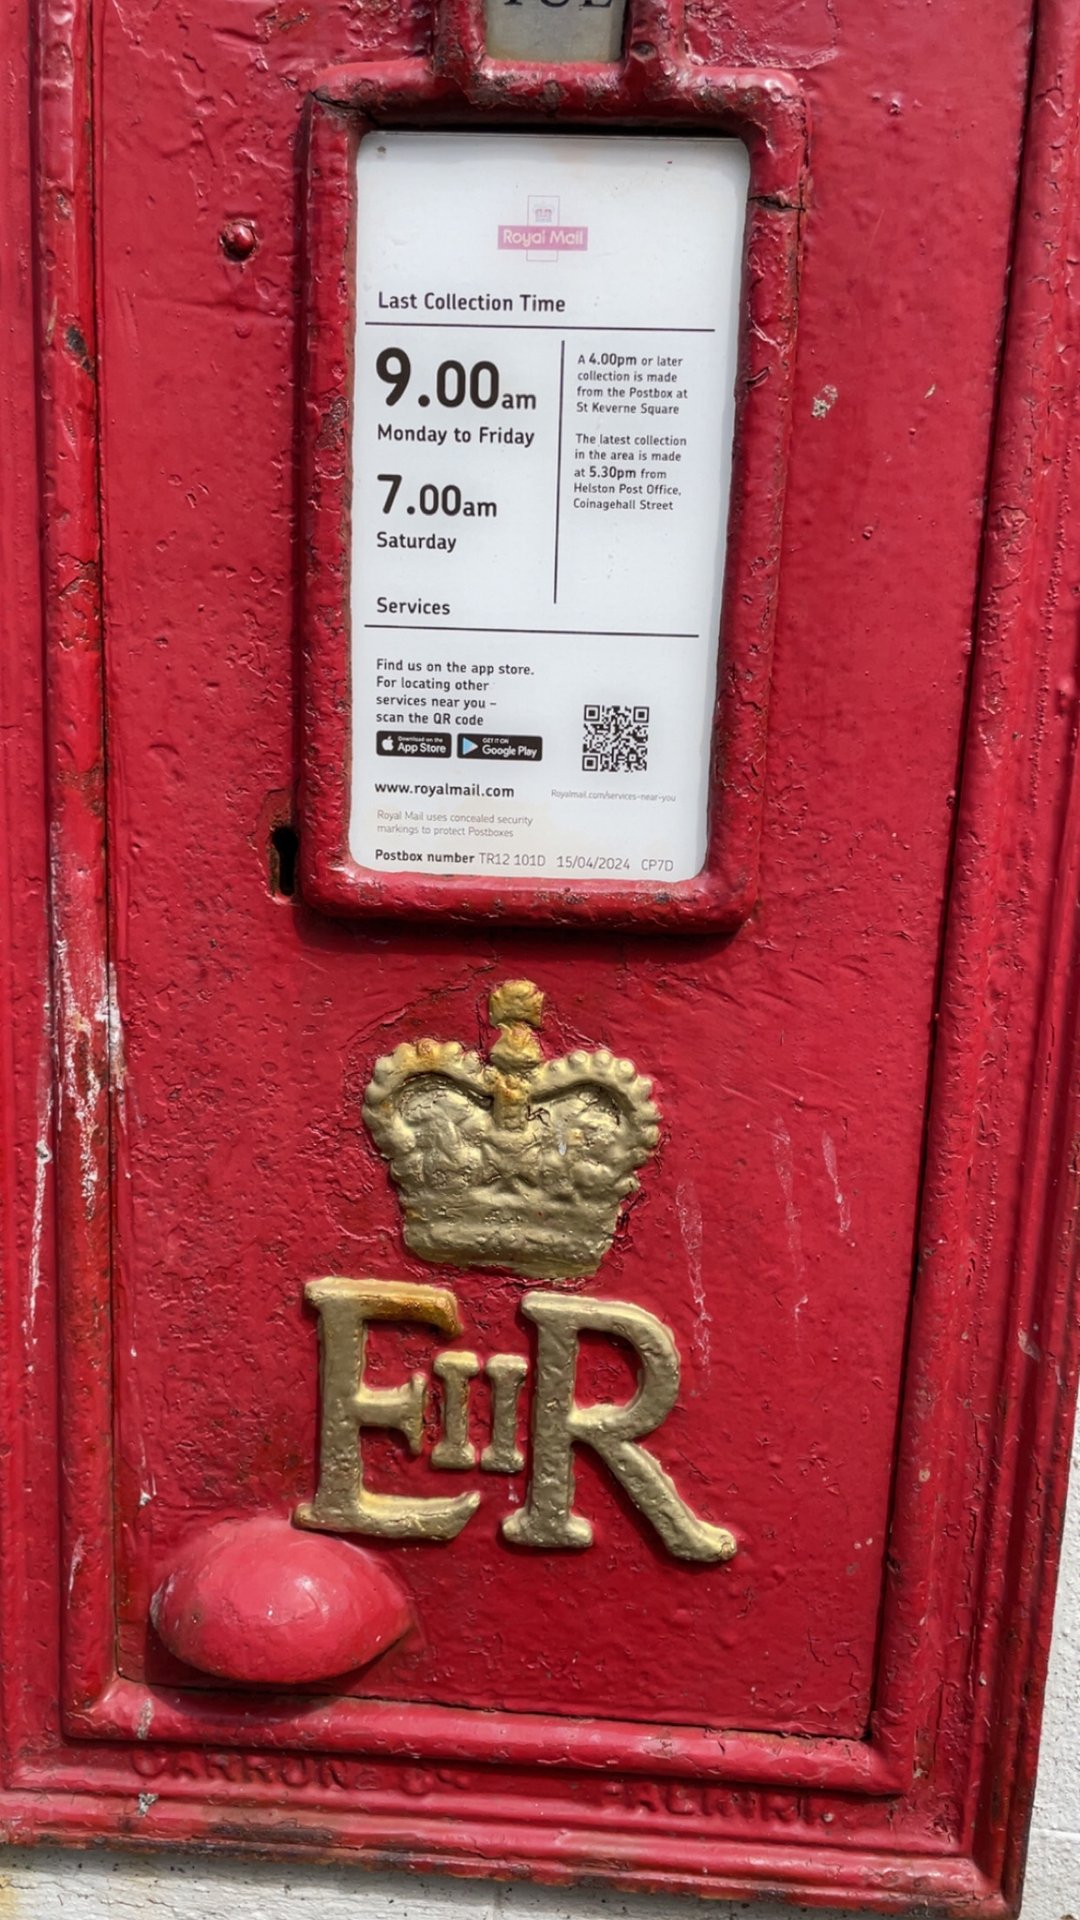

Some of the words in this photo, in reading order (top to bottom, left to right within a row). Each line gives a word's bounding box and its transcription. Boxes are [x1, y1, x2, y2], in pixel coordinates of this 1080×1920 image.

[502, 227, 546, 248] Royal
[549, 229, 584, 245] Mail
[378, 291, 418, 310] Last
[424, 292, 513, 312] Collection
[519, 294, 566, 313] Time
[577, 354, 586, 365] A
[588, 352, 637, 368] 4.00pm
[640, 357, 654, 367] or
[656, 355, 684, 367] later
[375, 346, 537, 410] 9.00am
[577, 370, 630, 382] collection
[633, 370, 644, 383] is
[646, 371, 678, 383] made
[576, 385, 604, 397] from
[606, 386, 626, 398] the
[629, 386, 673, 399] Postbox
[676, 388, 688, 399] at
[576, 401, 588, 413] St
[591, 401, 637, 414] Keverne
[640, 402, 680, 416] Square
[377, 423, 448, 446] Monday
[453, 427, 472, 443] to
[479, 426, 535, 449] Friday
[575, 432, 597, 445] The
[599, 433, 631, 445] latest
[633, 434, 687, 446] collection
[574, 448, 585, 460] in
[588, 449, 607, 461] the
[610, 451, 635, 461] area
[638, 449, 648, 462] is
[651, 450, 682, 462] made
[573, 467, 586, 478] at
[589, 465, 637, 481] 5.30pm
[640, 467, 667, 479] from
[376, 473, 497, 518] 7.00am
[573, 482, 616, 494] Helston
[618, 483, 643, 495] Post
[646, 483, 682, 496] Office,
[573, 497, 636, 512] Coinagehall
[639, 499, 674, 511] Street
[376, 531, 457, 554] Saturday
[376, 596, 451, 616] Services
[376, 658, 404, 671] Find
[407, 662, 422, 672] us
[426, 663, 442, 672] on
[446, 661, 467, 673] the
[470, 664, 495, 676] app
[498, 663, 535, 676] store.
[376, 675, 397, 688] For
[401, 676, 451, 693] locating
[454, 679, 490, 692] other
[375, 694, 427, 707] services
[431, 698, 461, 708] near
[463, 699, 486, 711] you
[375, 713, 405, 723] scan
[408, 712, 429, 724] the
[433, 712, 451, 725] QR
[454, 714, 484, 726] code
[397, 742, 419, 754] App
[419, 742, 447, 754] Store
[481, 744, 517, 758] Google
[517, 745, 538, 759] Play
[374, 782, 515, 800] www.royalmail.com
[376, 809, 402, 822] Royal
[404, 810, 424, 822] Mail
[425, 813, 448, 822] uses
[449, 813, 495, 824] concealed
[496, 816, 534, 827] security
[376, 823, 420, 836] markings
[421, 825, 432, 835] to
[433, 826, 466, 836] protect
[467, 825, 514, 838] Postboxes
[375, 848, 423, 862] Postbox
[427, 852, 475, 864] number
[478, 852, 511, 866] TR12
[513, 853, 546, 867] 101D
[556, 855, 631, 871] 15/04/2024
[640, 858, 674, 872] CP7D
